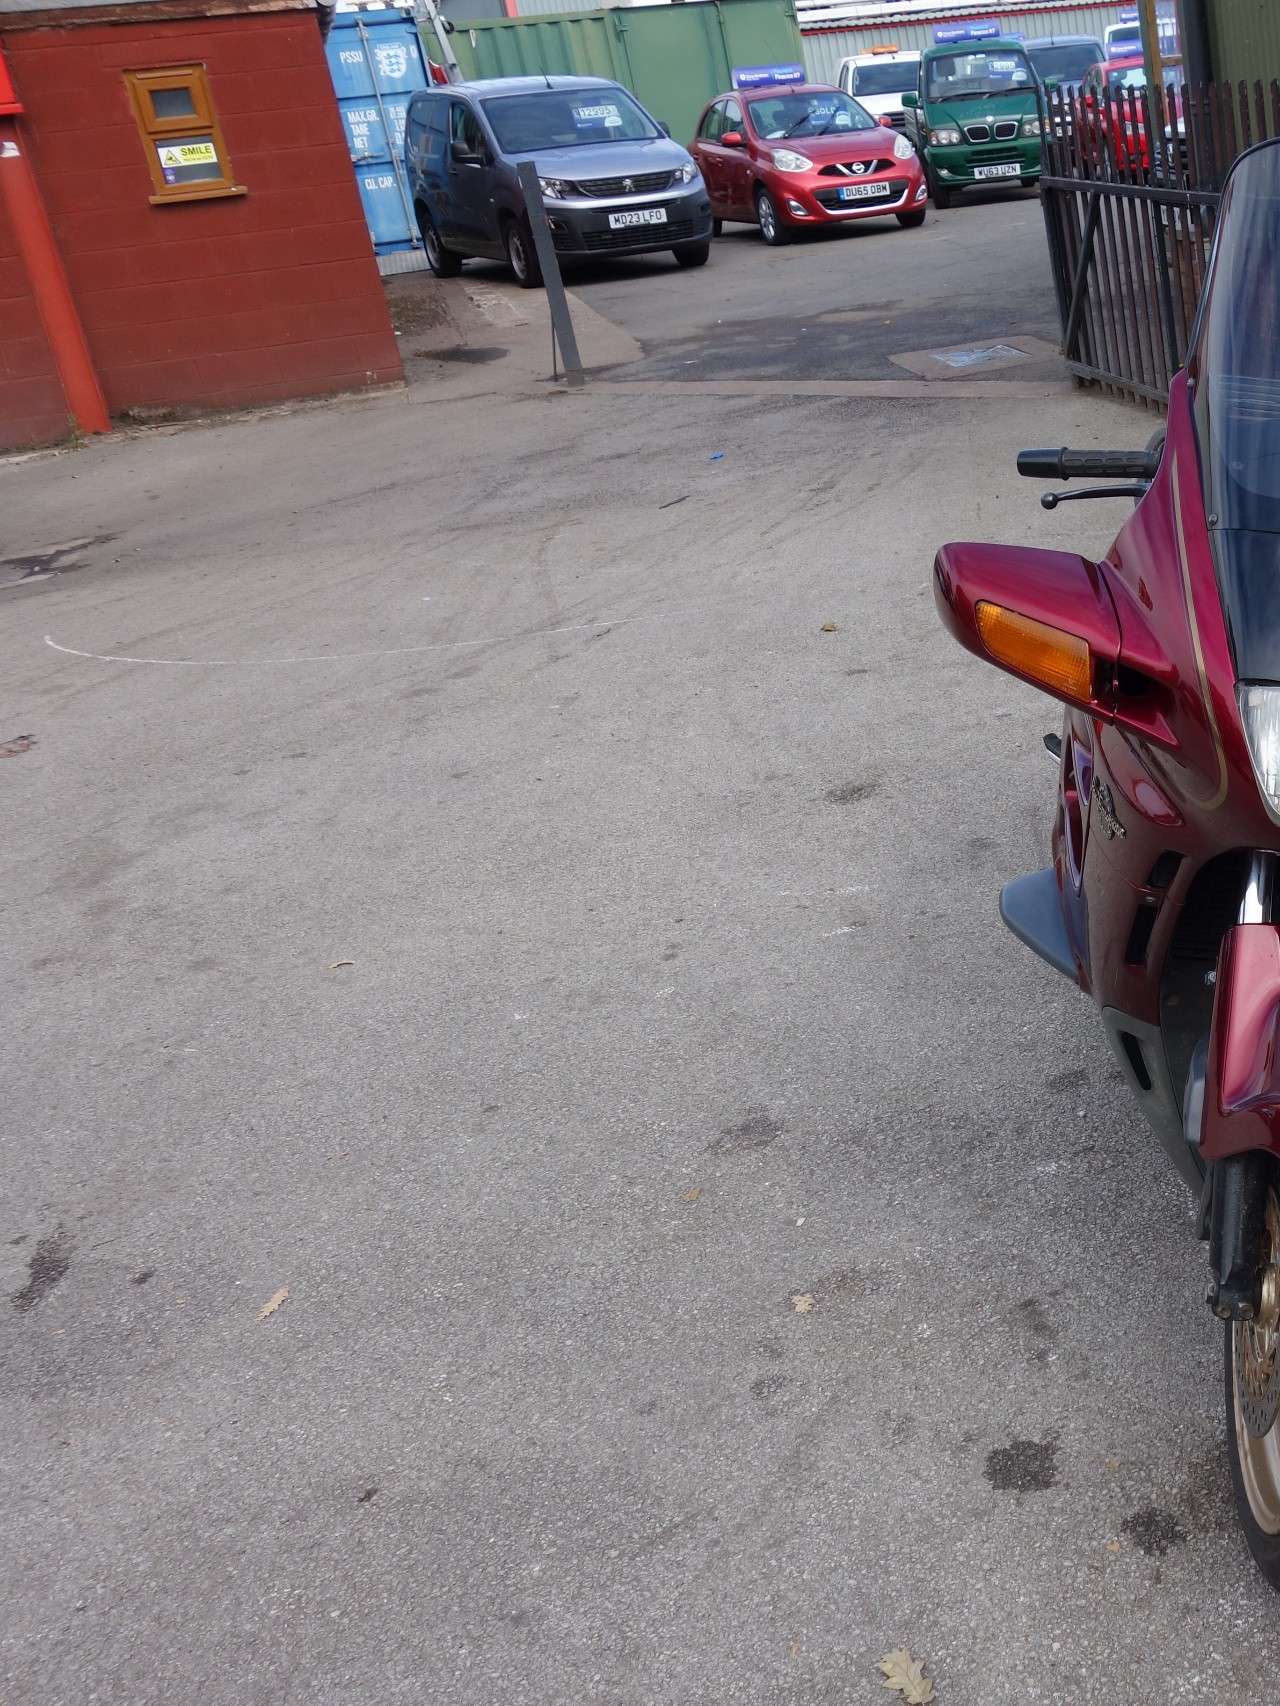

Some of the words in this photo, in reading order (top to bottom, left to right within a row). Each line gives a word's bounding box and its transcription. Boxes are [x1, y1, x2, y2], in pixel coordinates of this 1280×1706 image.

[340, 50, 363, 64] PSSU
[353, 136, 368, 149] NET
[180, 145, 213, 157] SMILE
[845, 185, 869, 198] DU65
[870, 183, 888, 195] OBM
[613, 212, 641, 226] MD23
[642, 209, 663, 223] LFO
